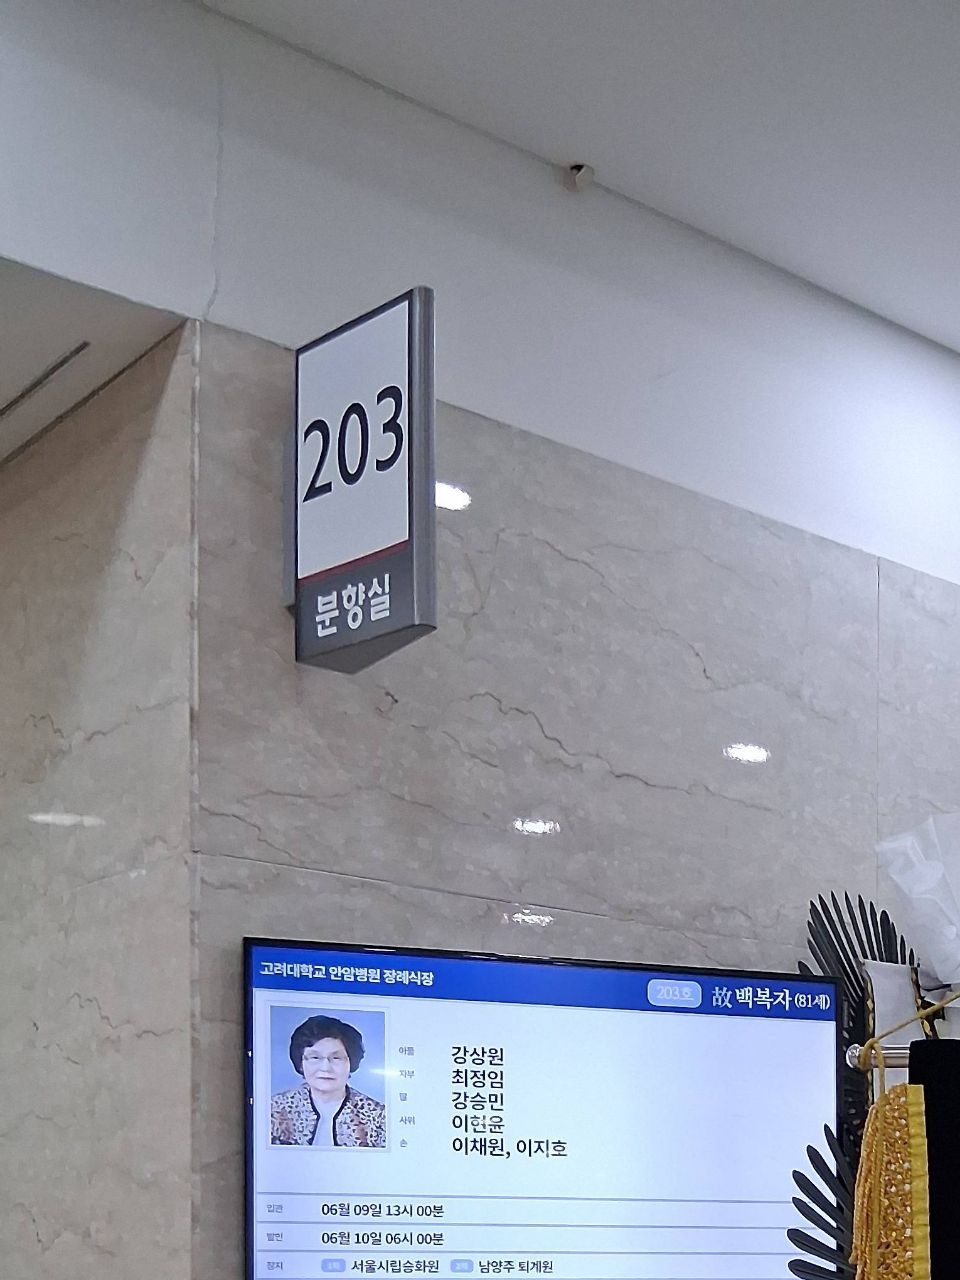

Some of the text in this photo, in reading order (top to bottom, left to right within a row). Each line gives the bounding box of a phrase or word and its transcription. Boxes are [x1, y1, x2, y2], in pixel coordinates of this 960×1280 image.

[302, 384, 405, 504] 203
[314, 572, 391, 638] 분향실
[260, 961, 435, 987] 고려대학교 안암병원 장례식장
[451, 1045, 504, 1067] 강상원
[451, 1068, 504, 1089] 최정임
[451, 1091, 504, 1112] 강승민
[451, 1136, 512, 1159] 이채원,
[516, 1138, 568, 1158] 이지호
[321, 1203, 351, 1217] 06월
[353, 1203, 382, 1218] 09일
[386, 1203, 414, 1218] 13시
[416, 1204, 445, 1218] 00분
[321, 1231, 351, 1246] 06월
[354, 1232, 382, 1246] 10일
[385, 1232, 414, 1246] 06시
[416, 1232, 445, 1246] 00분
[350, 1259, 440, 1274] 서울시립승화원
[478, 1260, 516, 1274] 남양주
[518, 1260, 554, 1274] 퇴계원
